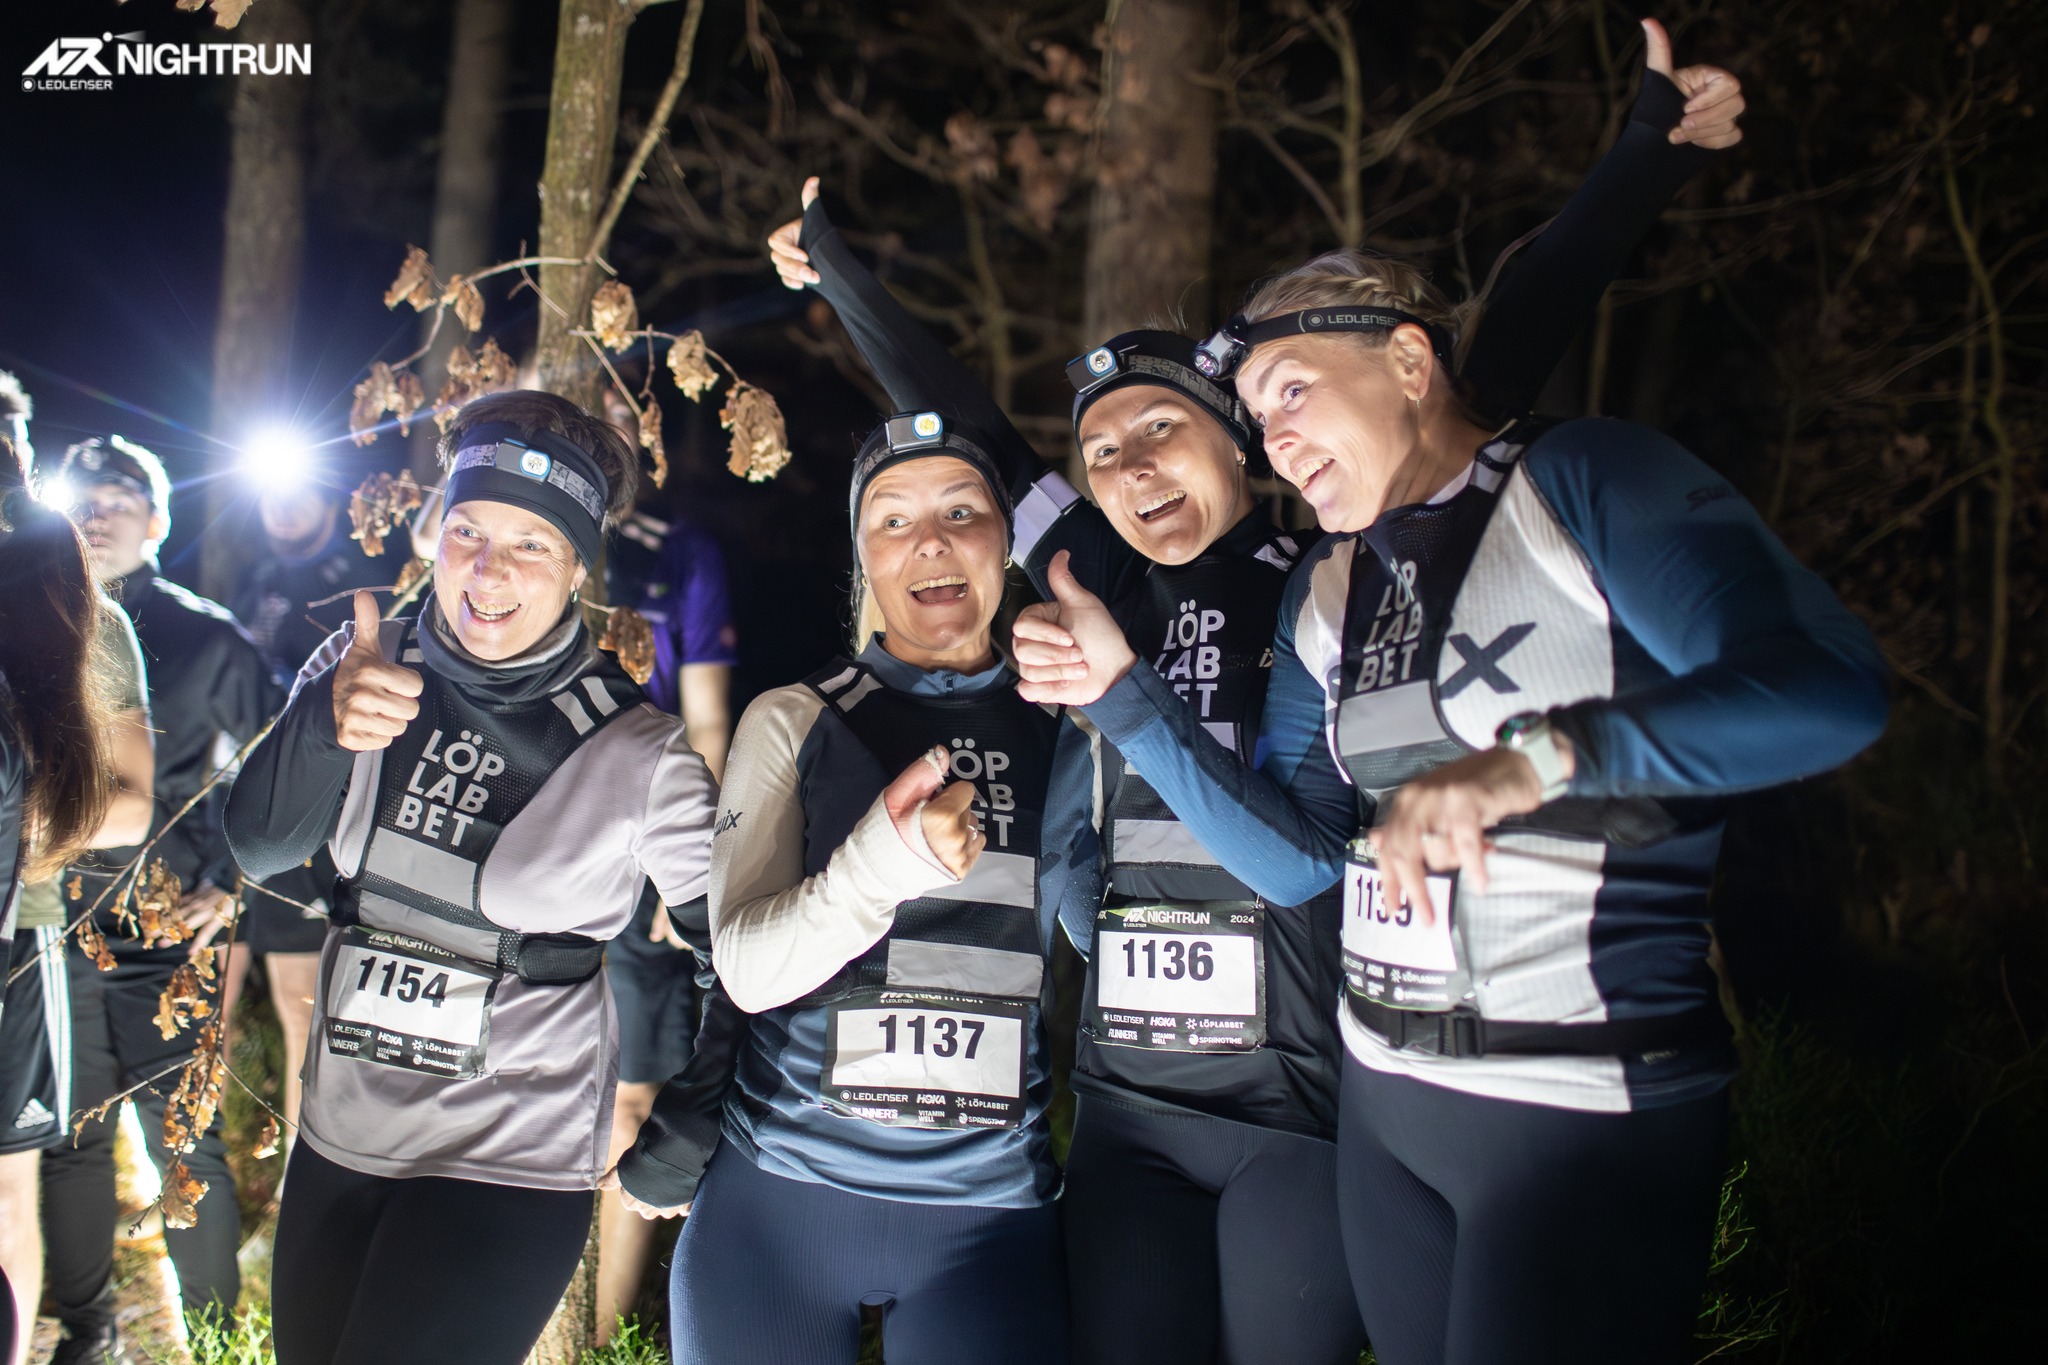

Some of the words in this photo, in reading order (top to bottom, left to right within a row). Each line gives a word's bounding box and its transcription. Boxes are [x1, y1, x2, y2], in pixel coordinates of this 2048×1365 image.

[1376, 556, 1418, 618] LÖP
[1162, 599, 1226, 651] LÖP
[1362, 602, 1424, 655] LAB
[1153, 645, 1221, 680] LAB
[1355, 641, 1420, 693] BET
[1173, 683, 1218, 718] ET
[421, 729, 506, 783] LÖP
[944, 738, 1010, 781] ÖP
[406, 760, 490, 815] LAB
[394, 794, 475, 847] BET
[1147, 911, 1210, 924] NIGHTRUN
[1230, 915, 1254, 923] 2024
[1122, 938, 1215, 982] 1136
[356, 955, 451, 1009] 1154
[331, 1024, 372, 1039] DLENSER
[878, 1014, 986, 1060] 1137
[1109, 1014, 1144, 1025] LEDLENSER
[1150, 1016, 1176, 1028] HOKA
[1199, 1019, 1245, 1029] LÖPLABBET
[378, 1031, 403, 1047] HOKA
[425, 1041, 467, 1056] LÖPLABBET
[1199, 1037, 1242, 1045] SPRINGTIME
[853, 1092, 908, 1103] LEDLENSER
[916, 1093, 946, 1105] HOKA
[918, 1109, 945, 1118] VITAMIN
[968, 1097, 1010, 1111] LÖPLABBET
